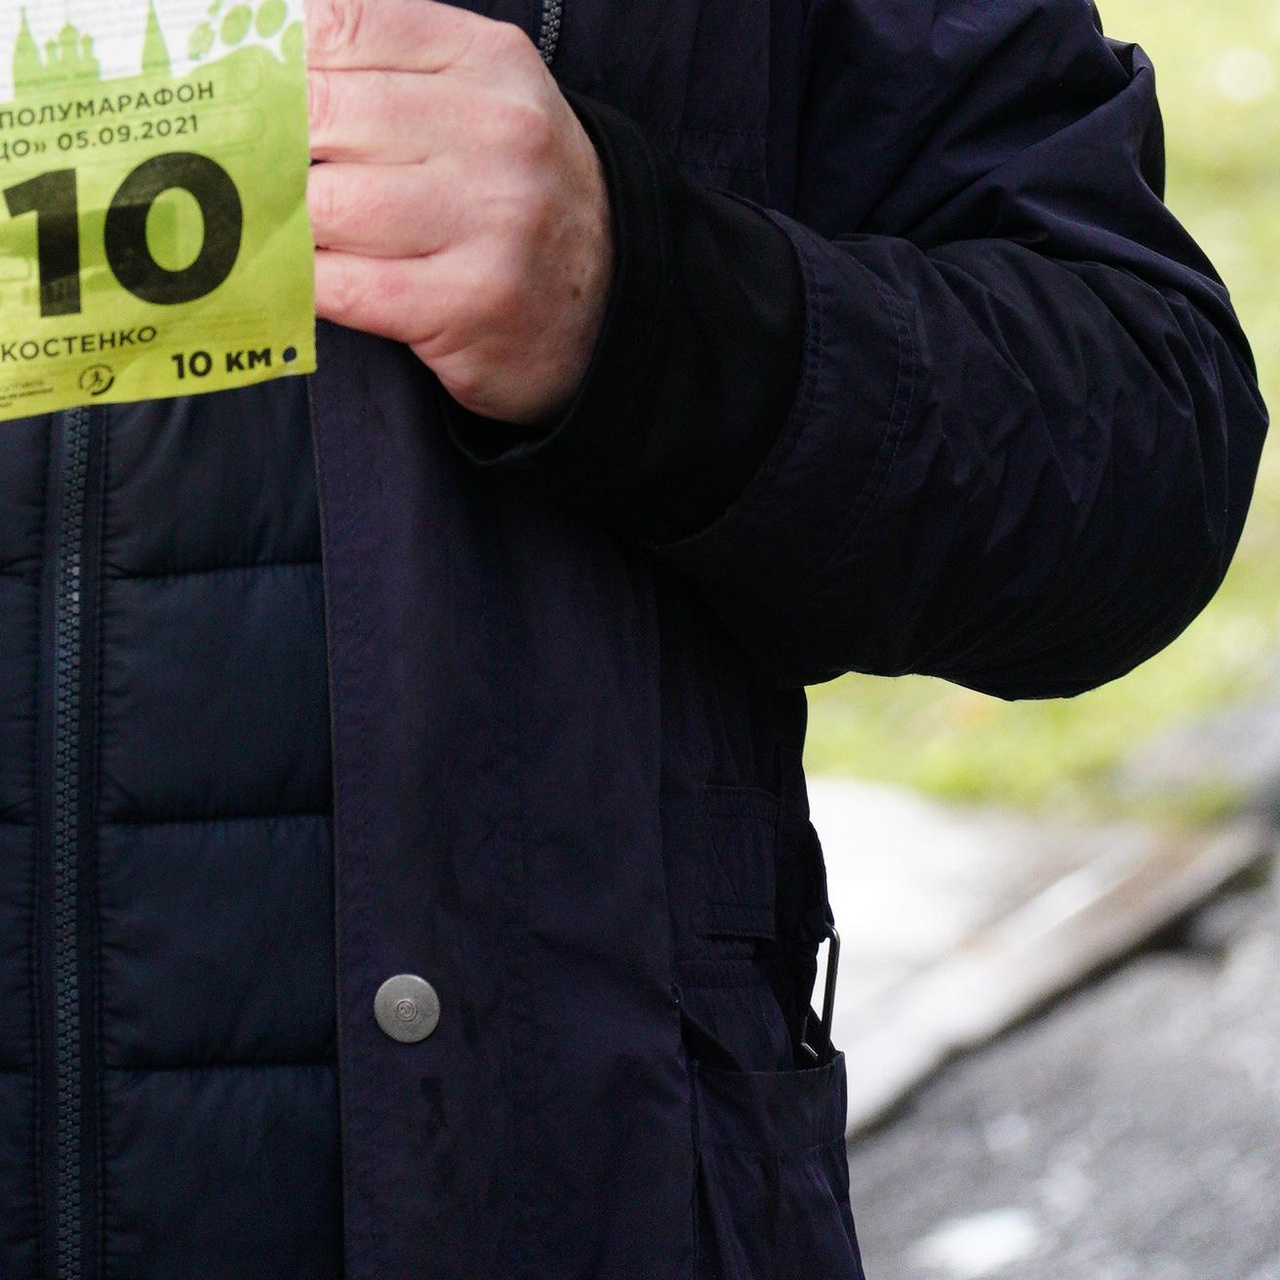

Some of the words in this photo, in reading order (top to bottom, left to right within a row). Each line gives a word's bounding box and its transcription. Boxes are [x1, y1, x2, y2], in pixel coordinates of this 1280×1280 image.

[57, 114, 198, 151] 05.09.2021
[1, 326, 157, 362] КОСТЕНКО
[171, 351, 213, 380] 10
